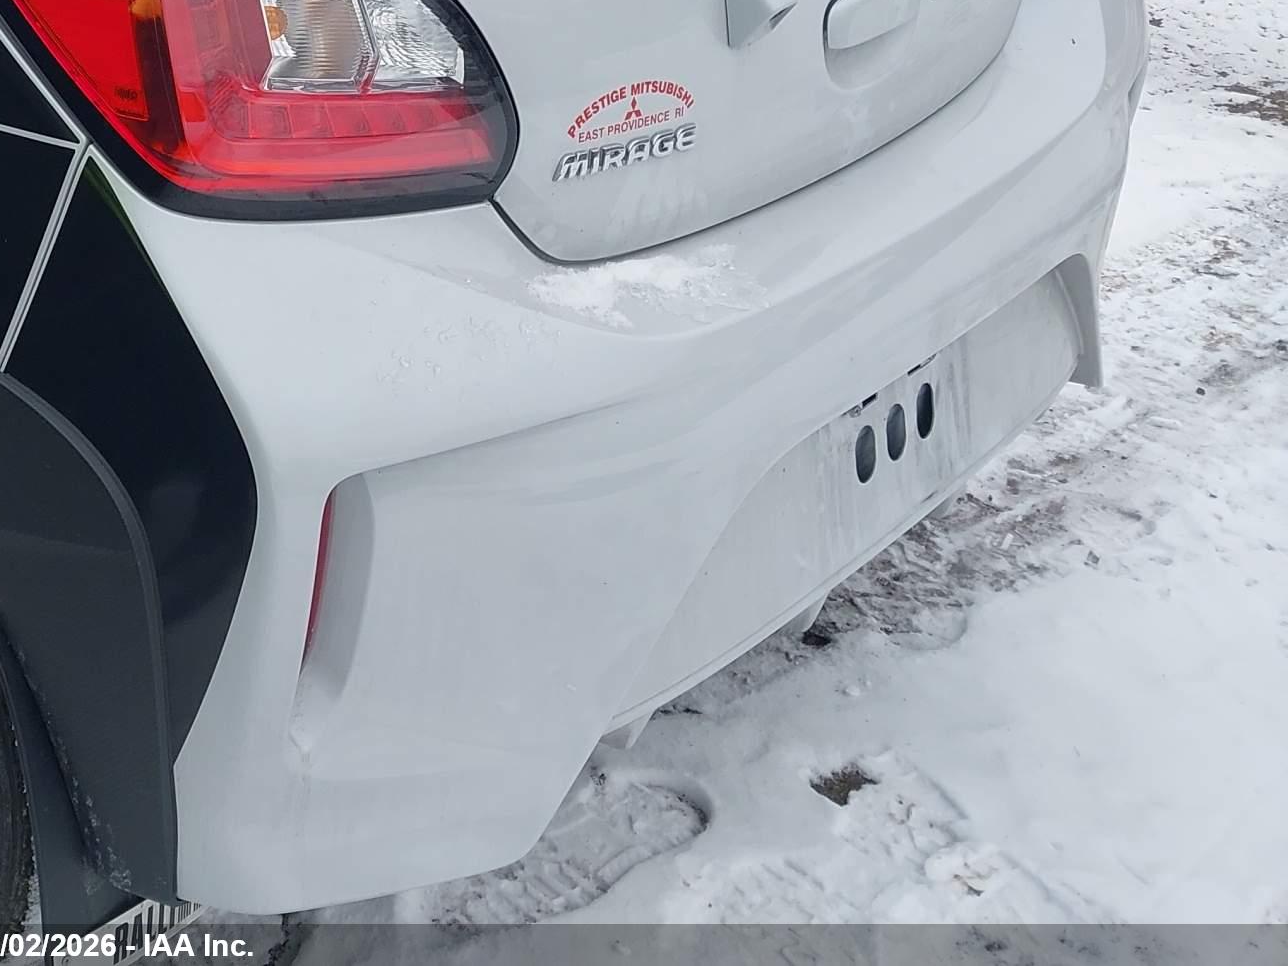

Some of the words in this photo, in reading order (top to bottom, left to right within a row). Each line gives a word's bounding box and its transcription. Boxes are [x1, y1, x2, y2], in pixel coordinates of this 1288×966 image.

[567, 86, 627, 138] PRESTIGE
[630, 80, 695, 108] MITSUBISHI
[578, 126, 605, 143] EAST
[607, 110, 670, 135] PROVIDENCE
[674, 106, 685, 118] RI
[552, 122, 696, 181] MIRAGE
